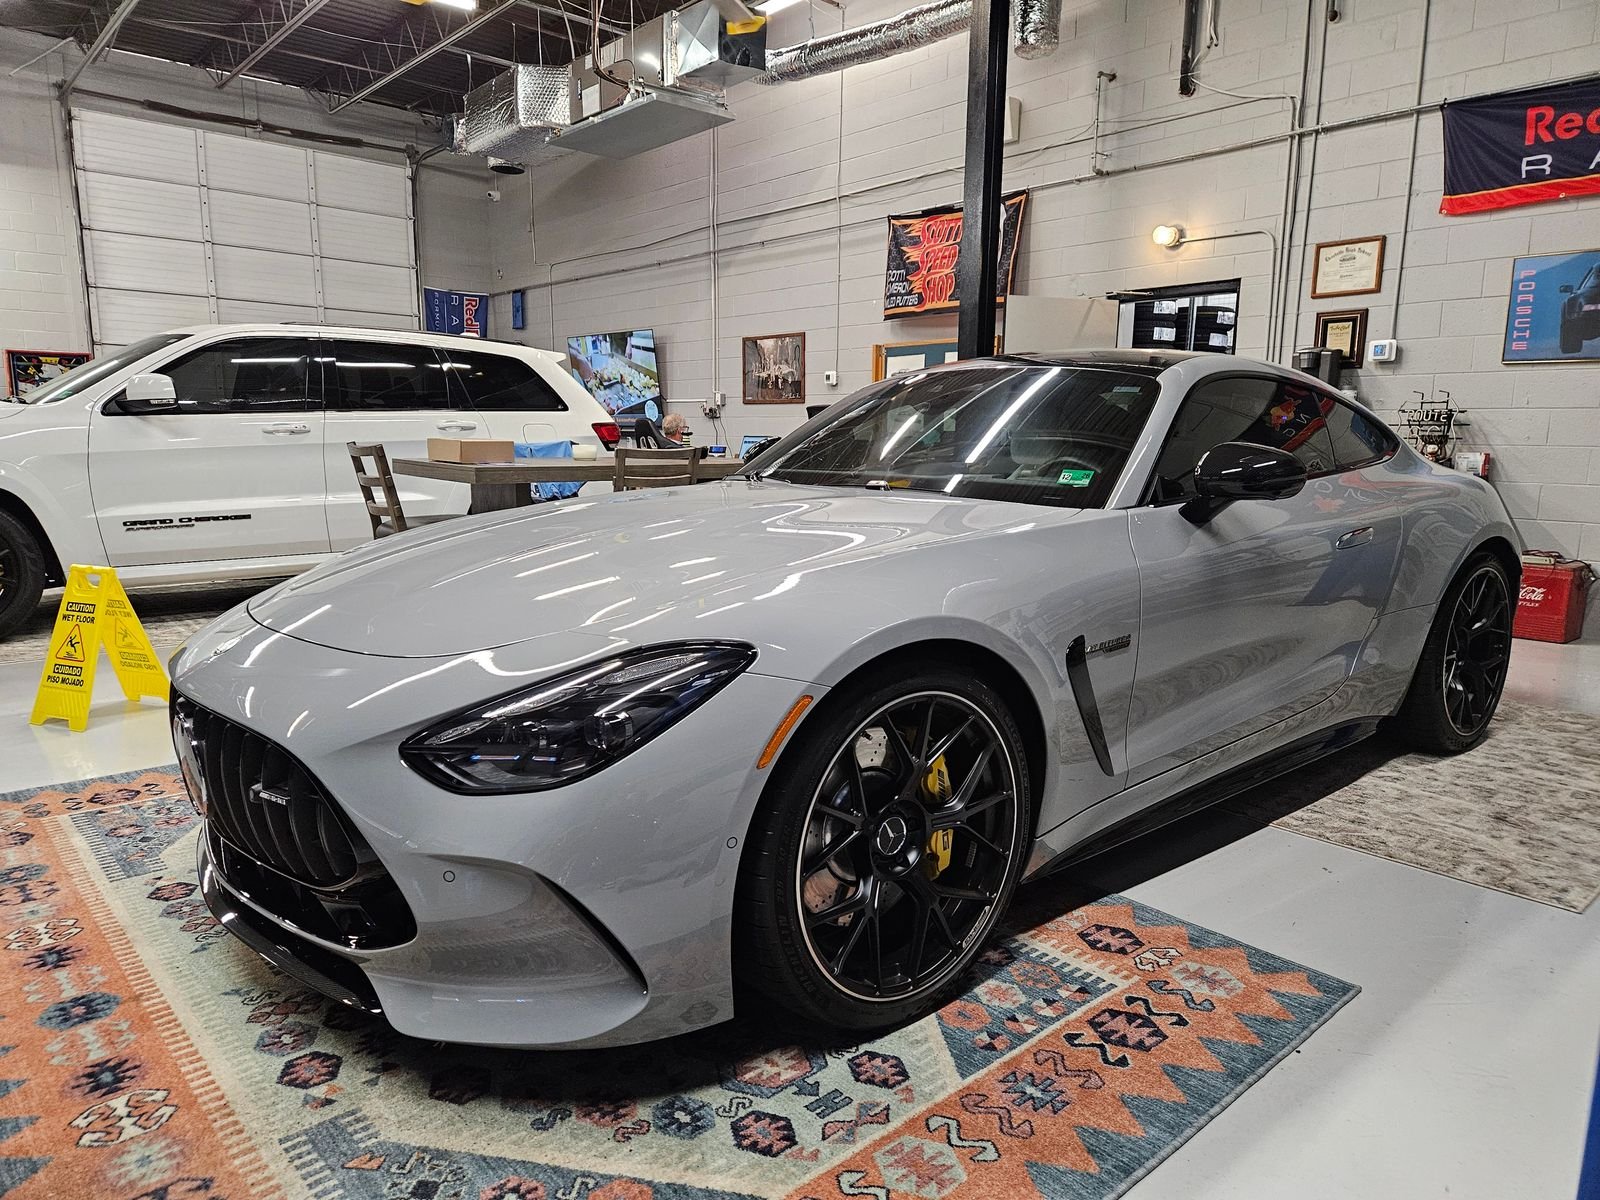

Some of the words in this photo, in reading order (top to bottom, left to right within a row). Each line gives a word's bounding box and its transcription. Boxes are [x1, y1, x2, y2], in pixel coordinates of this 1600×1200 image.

[919, 244, 960, 273] SPEED
[920, 272, 956, 304] SHOP
[464, 297, 480, 328] Red
[1512, 269, 1537, 351] PORSCHE
[1405, 409, 1449, 422] ROUTE
[1062, 473, 1072, 481] 12
[123, 519, 173, 527] GRAND
[179, 514, 251, 523] CHEROKEE
[1519, 587, 1547, 600] Cola
[67, 602, 95, 613] CAUTION
[62, 613, 74, 622] WET
[76, 614, 95, 624] FLOOR
[54, 664, 81, 676] CUIDADO
[46, 675, 60, 684] PISO
[60, 676, 84, 687] MOJADO
